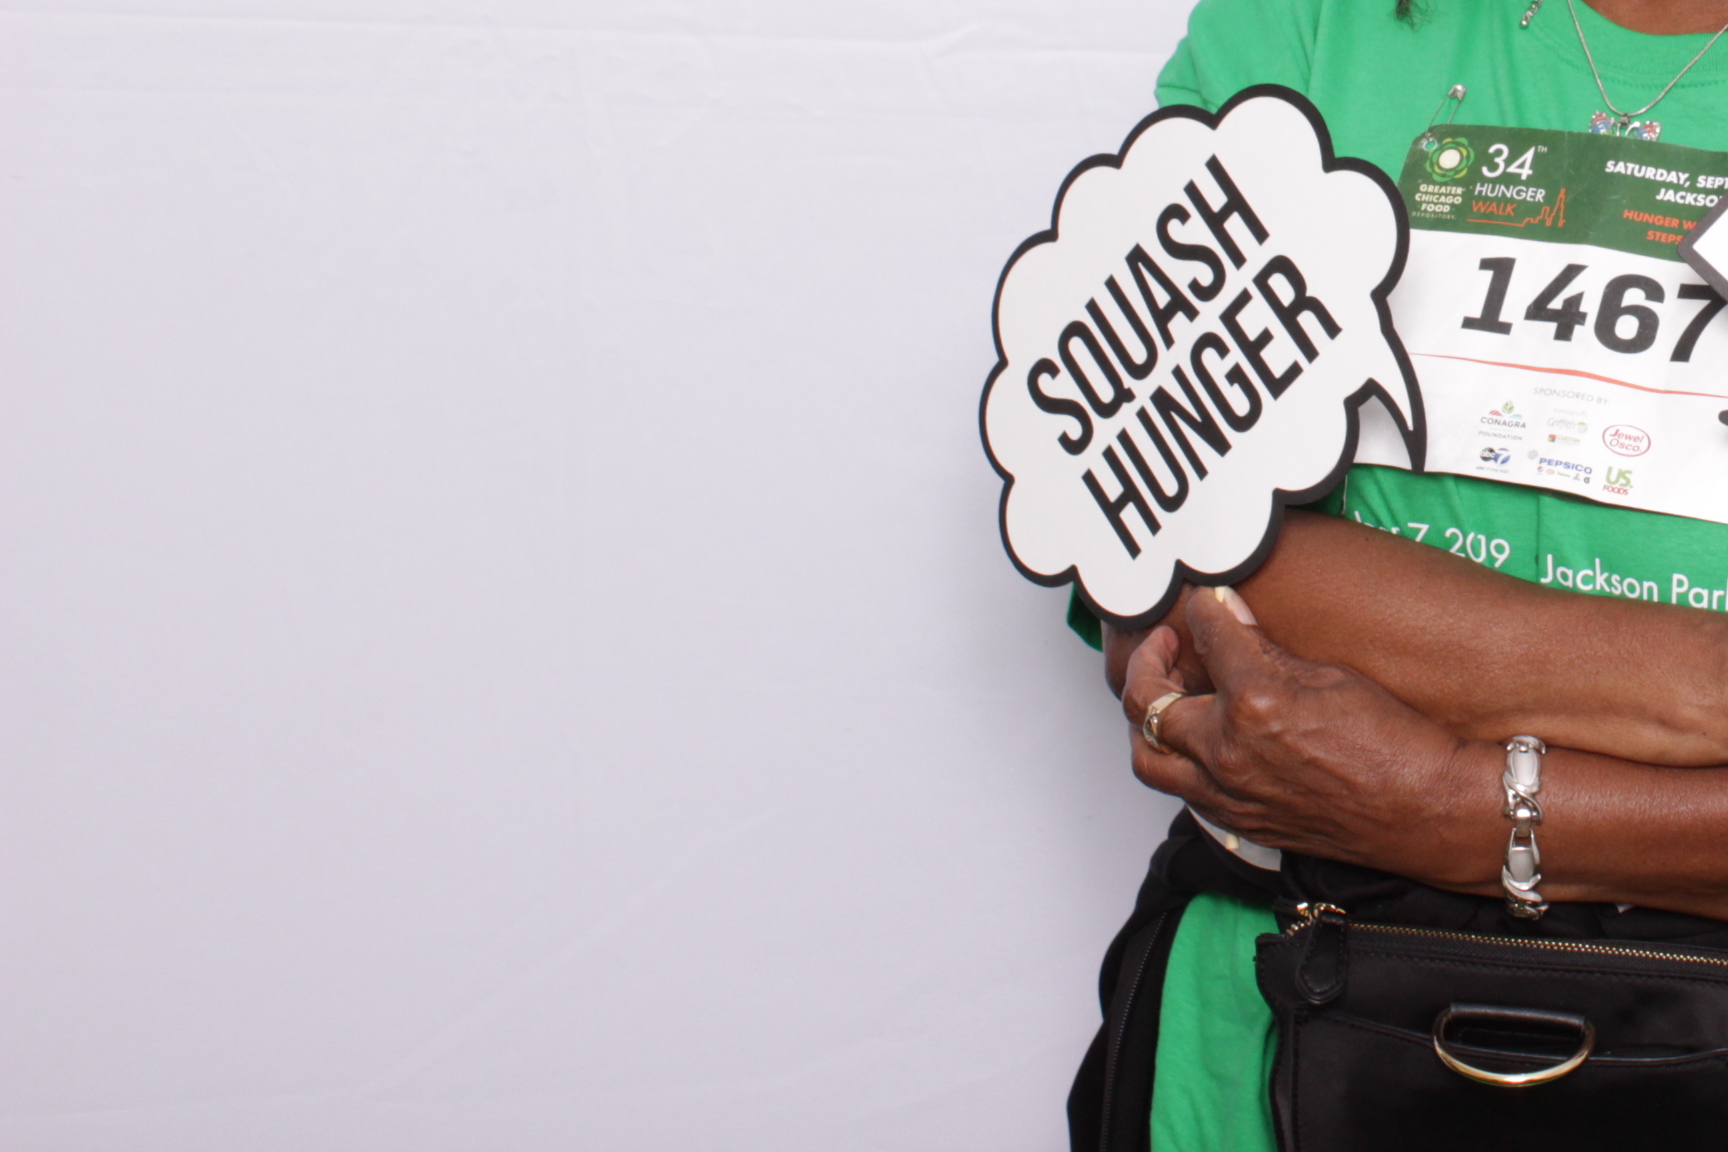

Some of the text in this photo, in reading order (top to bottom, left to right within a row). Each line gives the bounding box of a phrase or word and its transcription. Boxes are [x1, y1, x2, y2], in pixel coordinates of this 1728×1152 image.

[1605, 160, 1691, 188] SATURDAY,
[1420, 184, 1463, 194] GREATER
[1475, 182, 1546, 203] HUNGER
[1656, 188, 1722, 207] JACKSO
[1415, 193, 1462, 204] CHICAGO
[1421, 203, 1450, 212] FOOD
[1472, 200, 1518, 216] WALK
[1623, 209, 1680, 228] HUNGER
[1027, 153, 1270, 455] SQUASH
[1461, 257, 1728, 362] 1467
[1533, 387, 1594, 402] SPONSORED
[1081, 255, 1343, 560] HUNGER
[1480, 416, 1526, 429] CONAGRA
[1478, 430, 1523, 441] FOUNDATION
[1610, 429, 1645, 443] Jewel
[1539, 457, 1592, 475] PEPSICO
[1603, 485, 1629, 495] FOODS
[1540, 554, 1658, 602] Jackson
